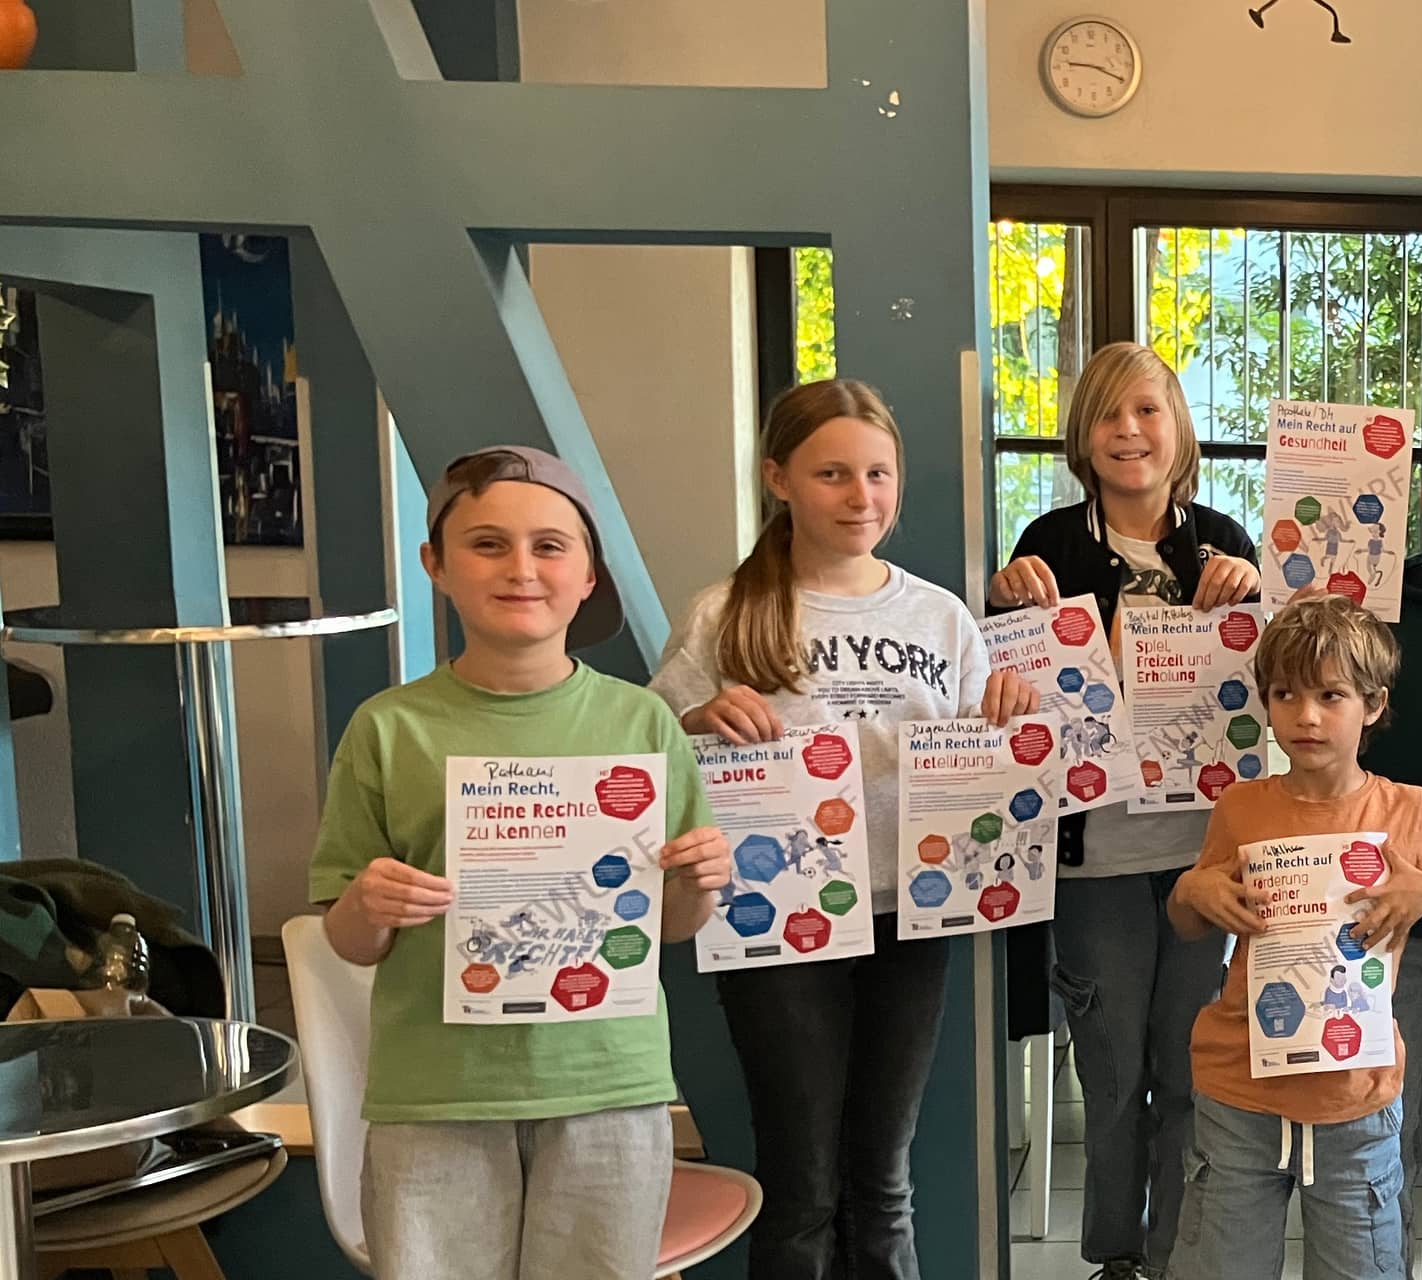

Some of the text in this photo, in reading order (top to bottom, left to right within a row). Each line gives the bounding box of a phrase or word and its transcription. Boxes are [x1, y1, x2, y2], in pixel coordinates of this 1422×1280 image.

[1277, 418, 1357, 434] Mein Recht auf
[1279, 434, 1347, 452] Gesundheit
[994, 629, 1026, 644] Recht
[1028, 622, 1046, 637] auf
[1131, 623, 1159, 635] Mein
[1162, 622, 1192, 634] Recht
[1195, 621, 1213, 633] auf
[990, 640, 1047, 665] dien und
[1136, 652, 1212, 668] Freizeit und
[844, 634, 950, 699] YORK
[1137, 669, 1196, 683] Erholung
[904, 720, 990, 741] Jugendhaus
[910, 735, 1003, 751] Mein Recht auf
[695, 750, 727, 766] Mein
[731, 748, 769, 763] Recht
[773, 746, 795, 761] auf
[914, 754, 994, 770] Beteiligung
[484, 761, 555, 780] Rathaus
[461, 782, 560, 798] Mein Recht,
[466, 801, 598, 819] meine Rechte
[466, 823, 567, 840] zu kennen
[1248, 853, 1333, 874] Mein Recht auf
[1272, 888, 1300, 902] einer
[1256, 902, 1327, 920] ehinderung
